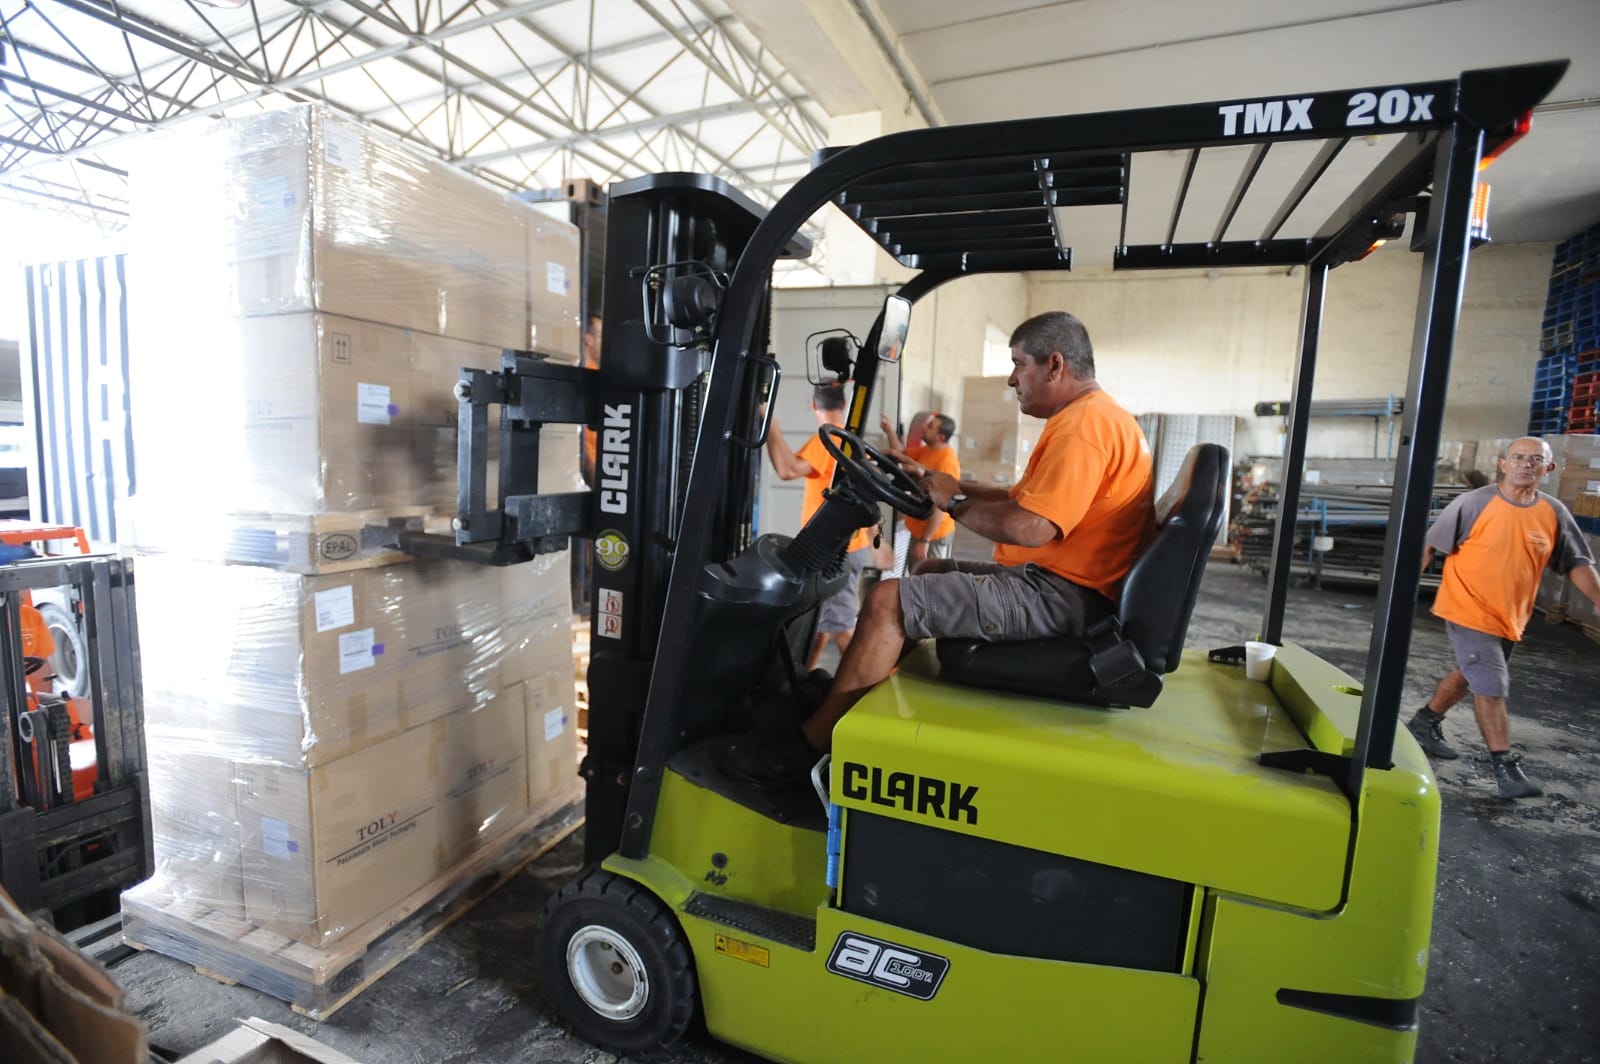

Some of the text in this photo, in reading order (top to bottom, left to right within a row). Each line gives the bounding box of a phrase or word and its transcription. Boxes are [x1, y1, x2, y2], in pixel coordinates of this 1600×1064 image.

[1219, 98, 1315, 136] TMX
[600, 403, 632, 515] CLARK
[325, 541, 353, 554] EPAL
[595, 537, 630, 556] 90
[843, 761, 979, 826] CLARK
[356, 810, 397, 841] TOLY
[336, 845, 370, 867] Passionate
